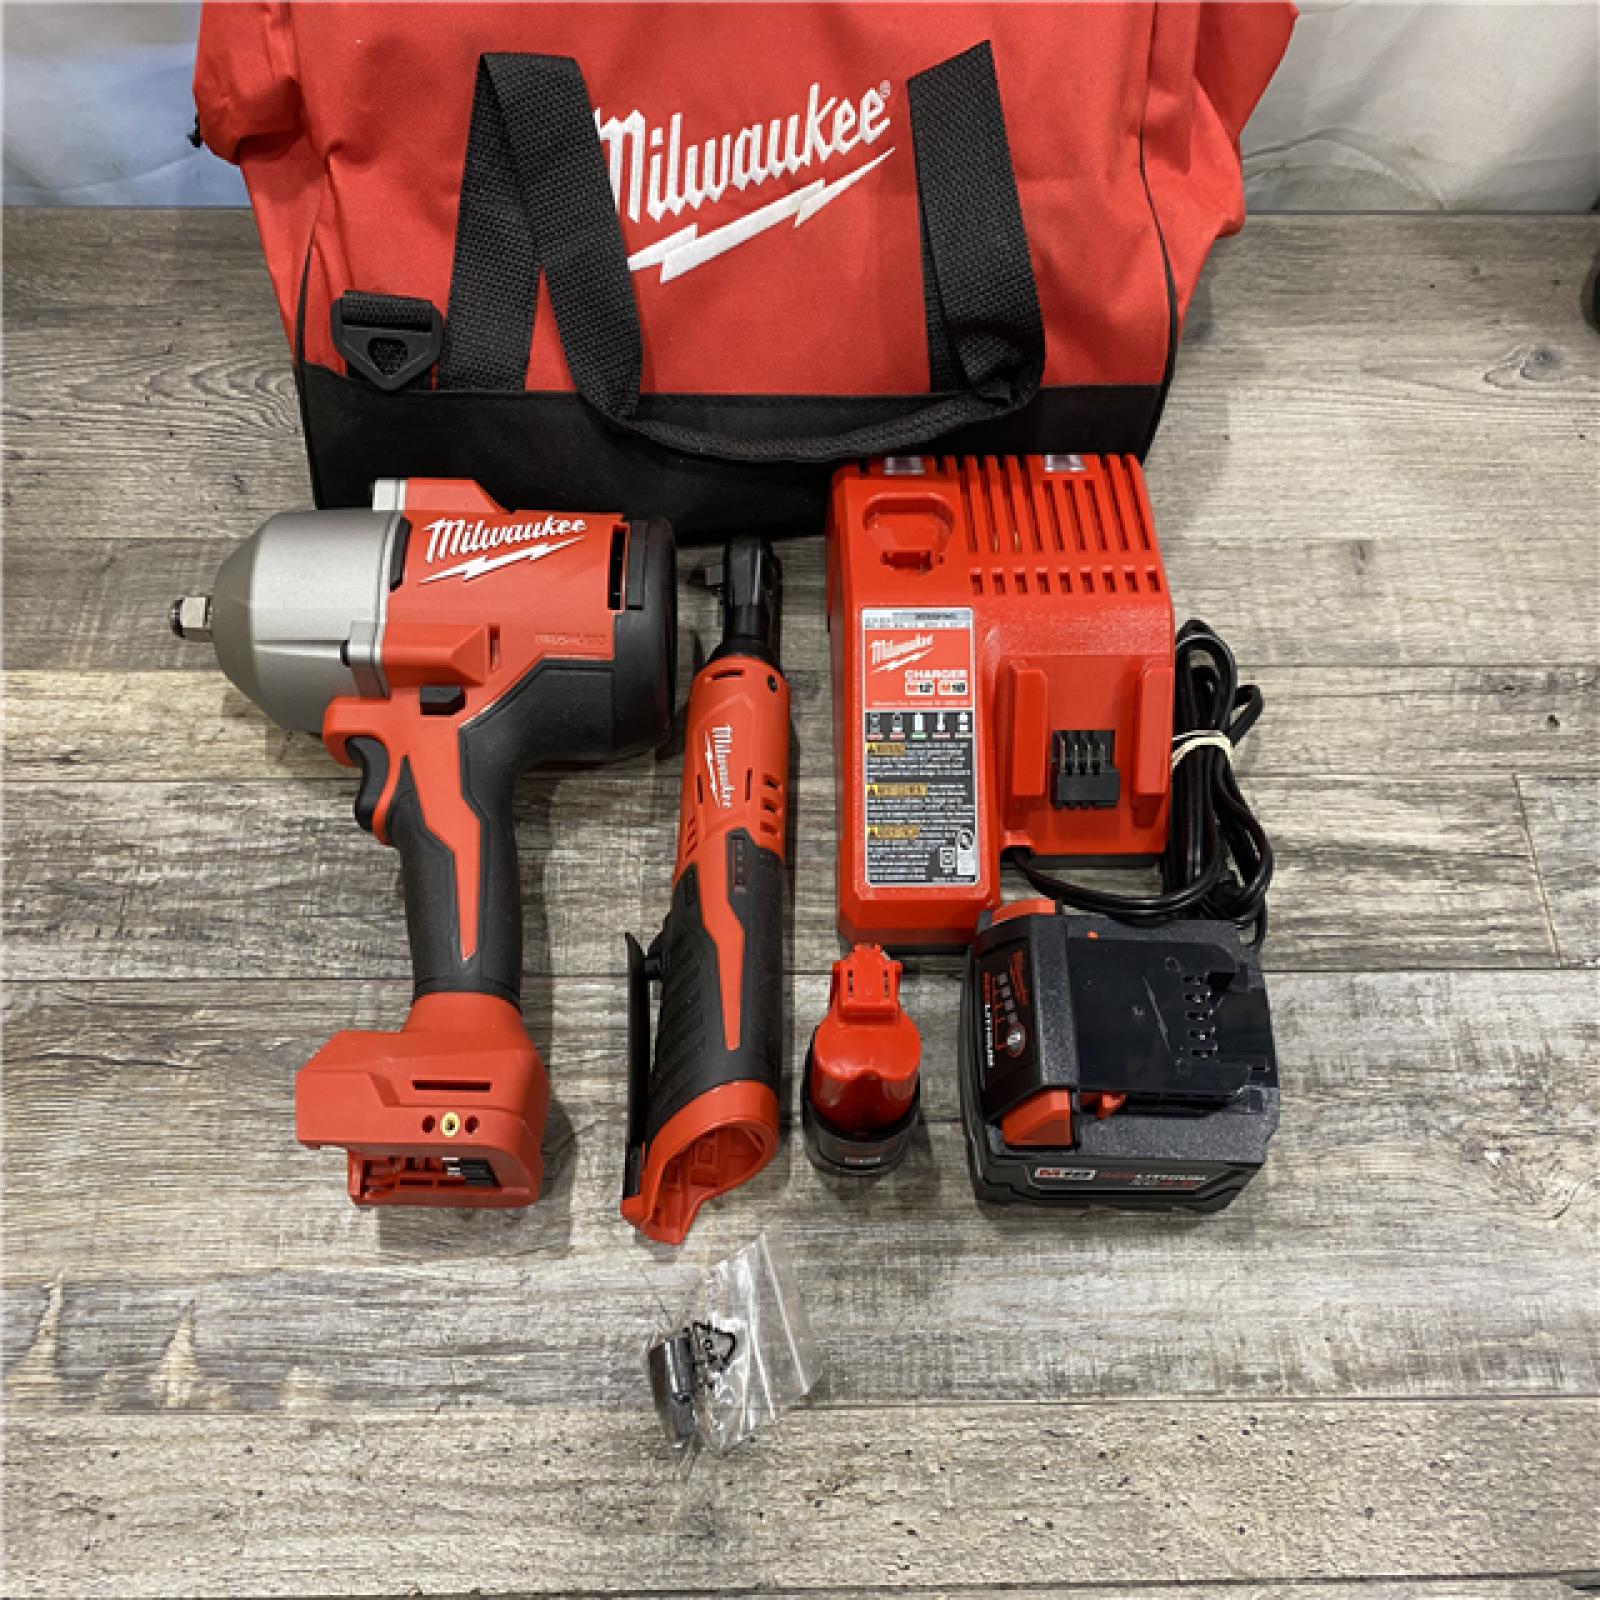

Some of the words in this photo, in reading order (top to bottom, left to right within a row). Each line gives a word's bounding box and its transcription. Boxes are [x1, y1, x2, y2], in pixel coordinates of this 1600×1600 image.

[595, 82, 890, 223] Milwaukee
[423, 516, 586, 563] Milwaukee
[905, 669, 968, 680] CHARGER
[712, 723, 735, 808] Milwaukee
